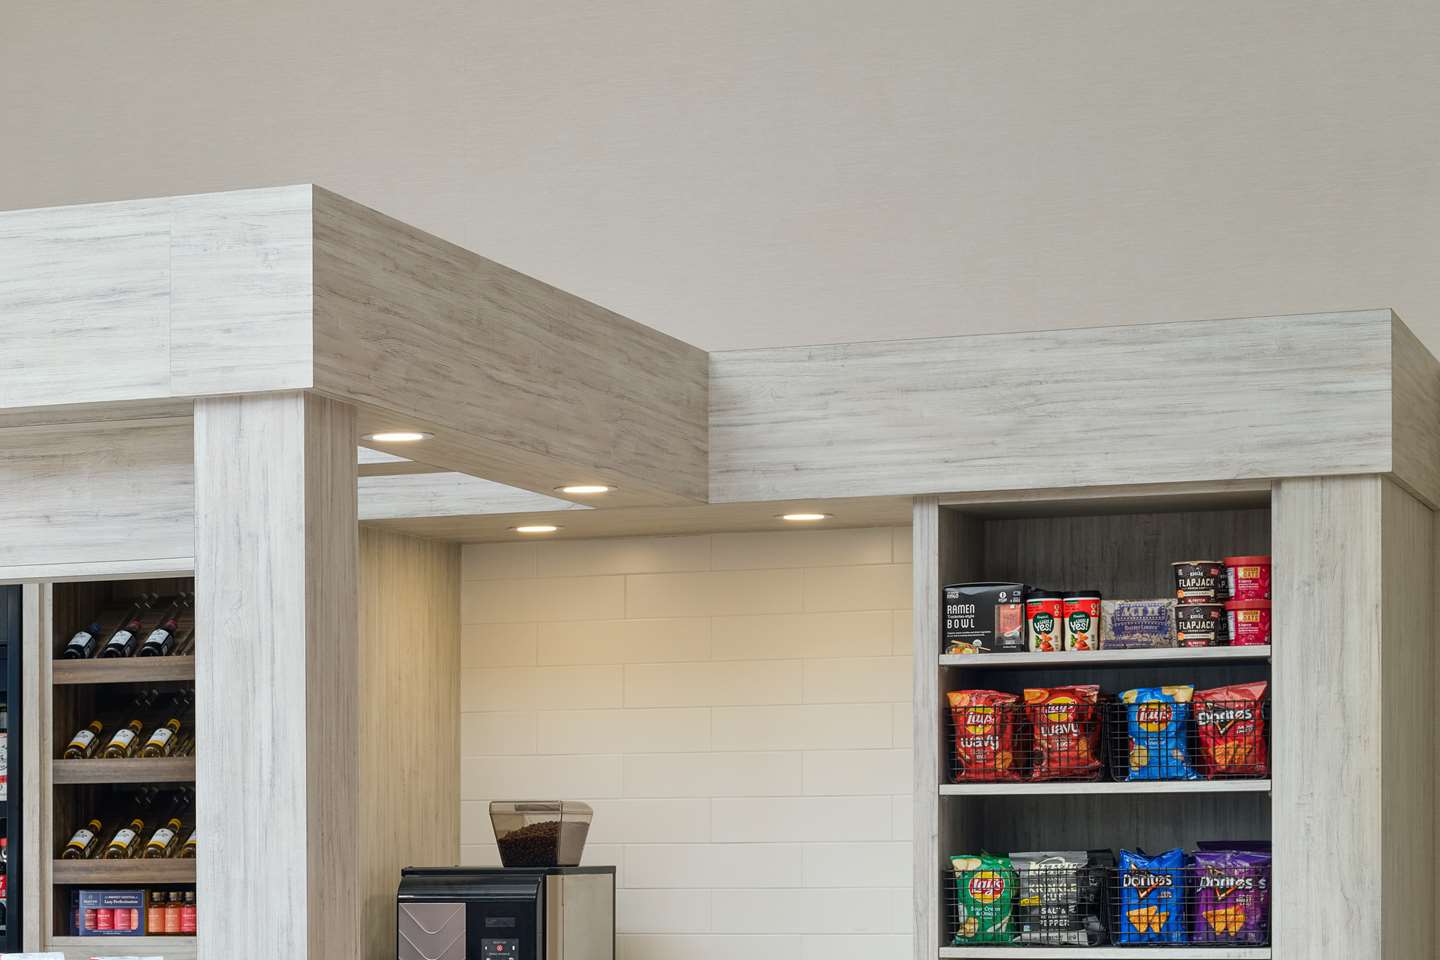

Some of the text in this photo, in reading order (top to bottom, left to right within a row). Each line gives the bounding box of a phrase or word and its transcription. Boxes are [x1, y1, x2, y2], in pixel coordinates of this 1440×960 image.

[947, 604, 975, 614] RAMEN
[947, 618, 975, 629] BOWL
[1179, 621, 1215, 630] FLAPJACK
